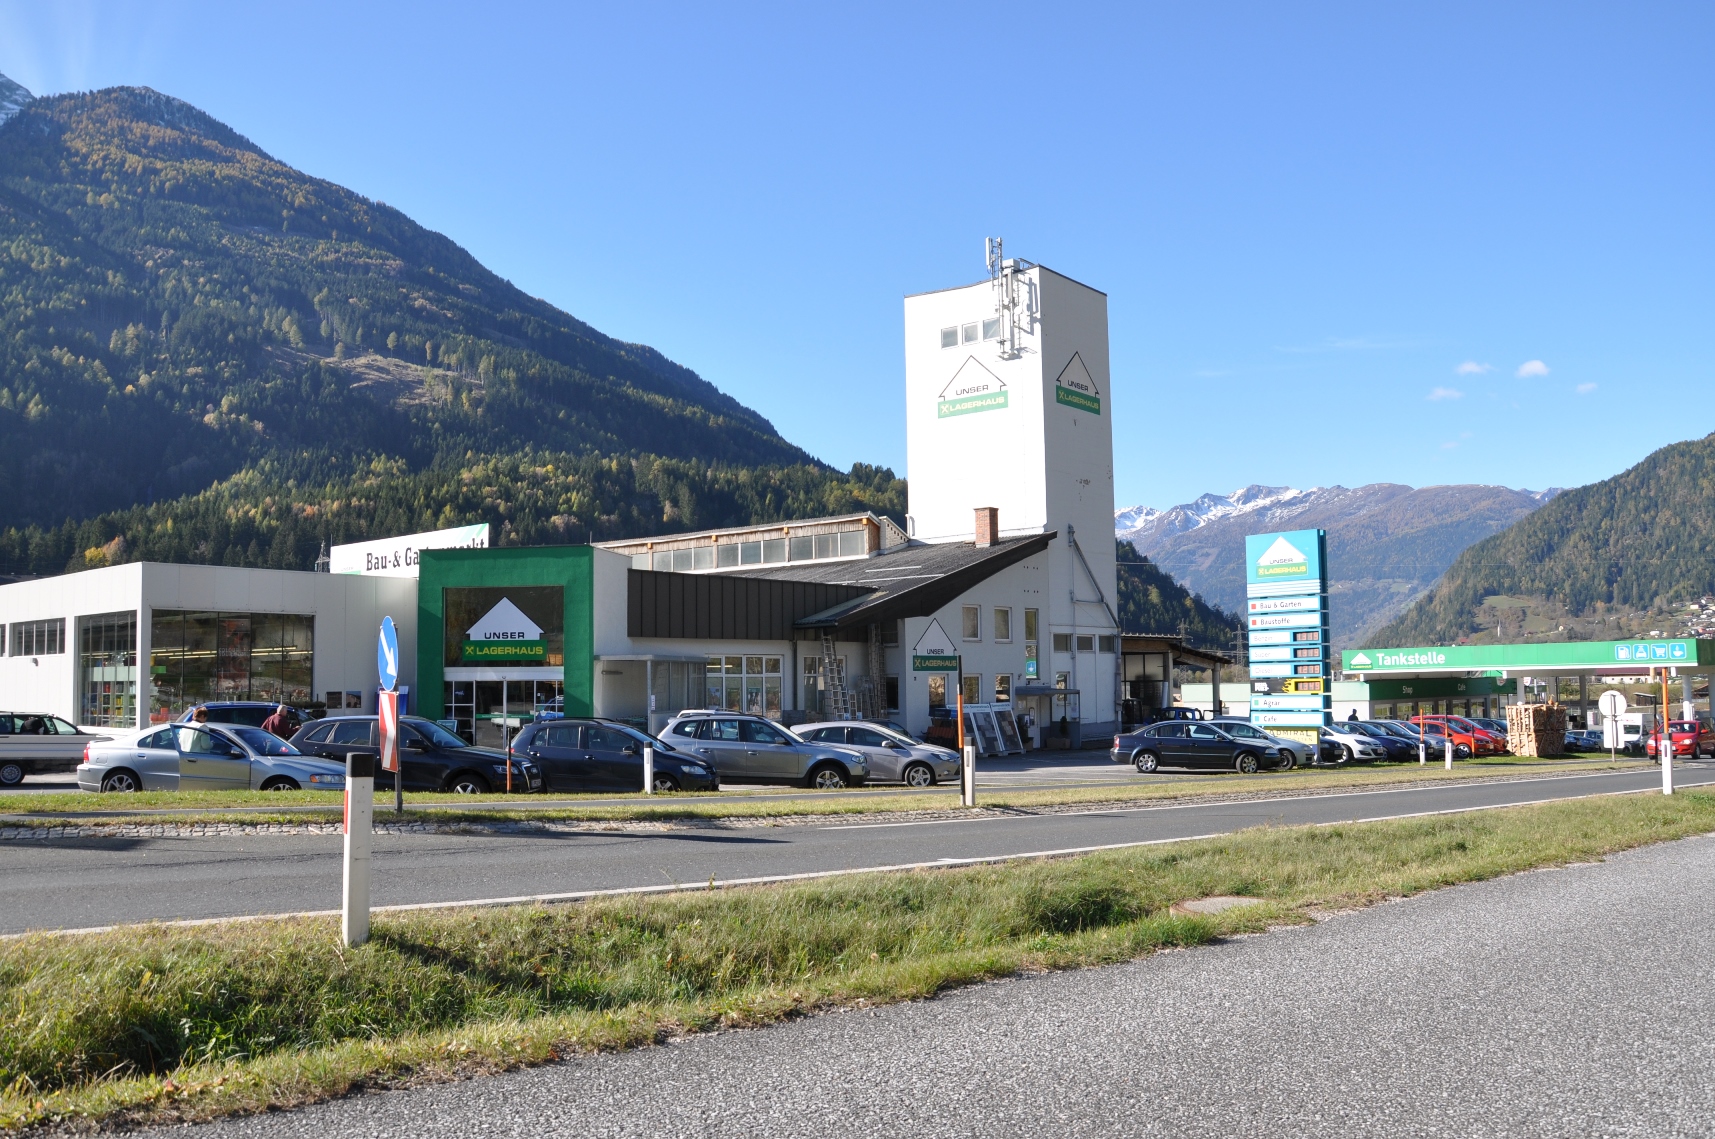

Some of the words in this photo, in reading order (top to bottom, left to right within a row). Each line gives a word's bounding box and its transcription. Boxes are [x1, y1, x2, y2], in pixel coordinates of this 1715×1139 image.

[956, 385, 989, 395] UNSER
[1067, 380, 1089, 392] UNSER
[949, 397, 1005, 412] LAGERHAUS
[1064, 394, 1099, 410] LAGERHAUS
[1264, 566, 1306, 575] LAGERHAUS
[1260, 602, 1272, 610] Bau
[1260, 618, 1290, 626] Baustoffe
[484, 632, 525, 640] UNSER
[476, 646, 544, 655] LAGERHAUS
[1376, 652, 1446, 666] Tankstelle
[1402, 685, 1414, 695] Shop
[1264, 700, 1280, 708] Agrar
[1269, 729, 1313, 738] ADMIRAL
